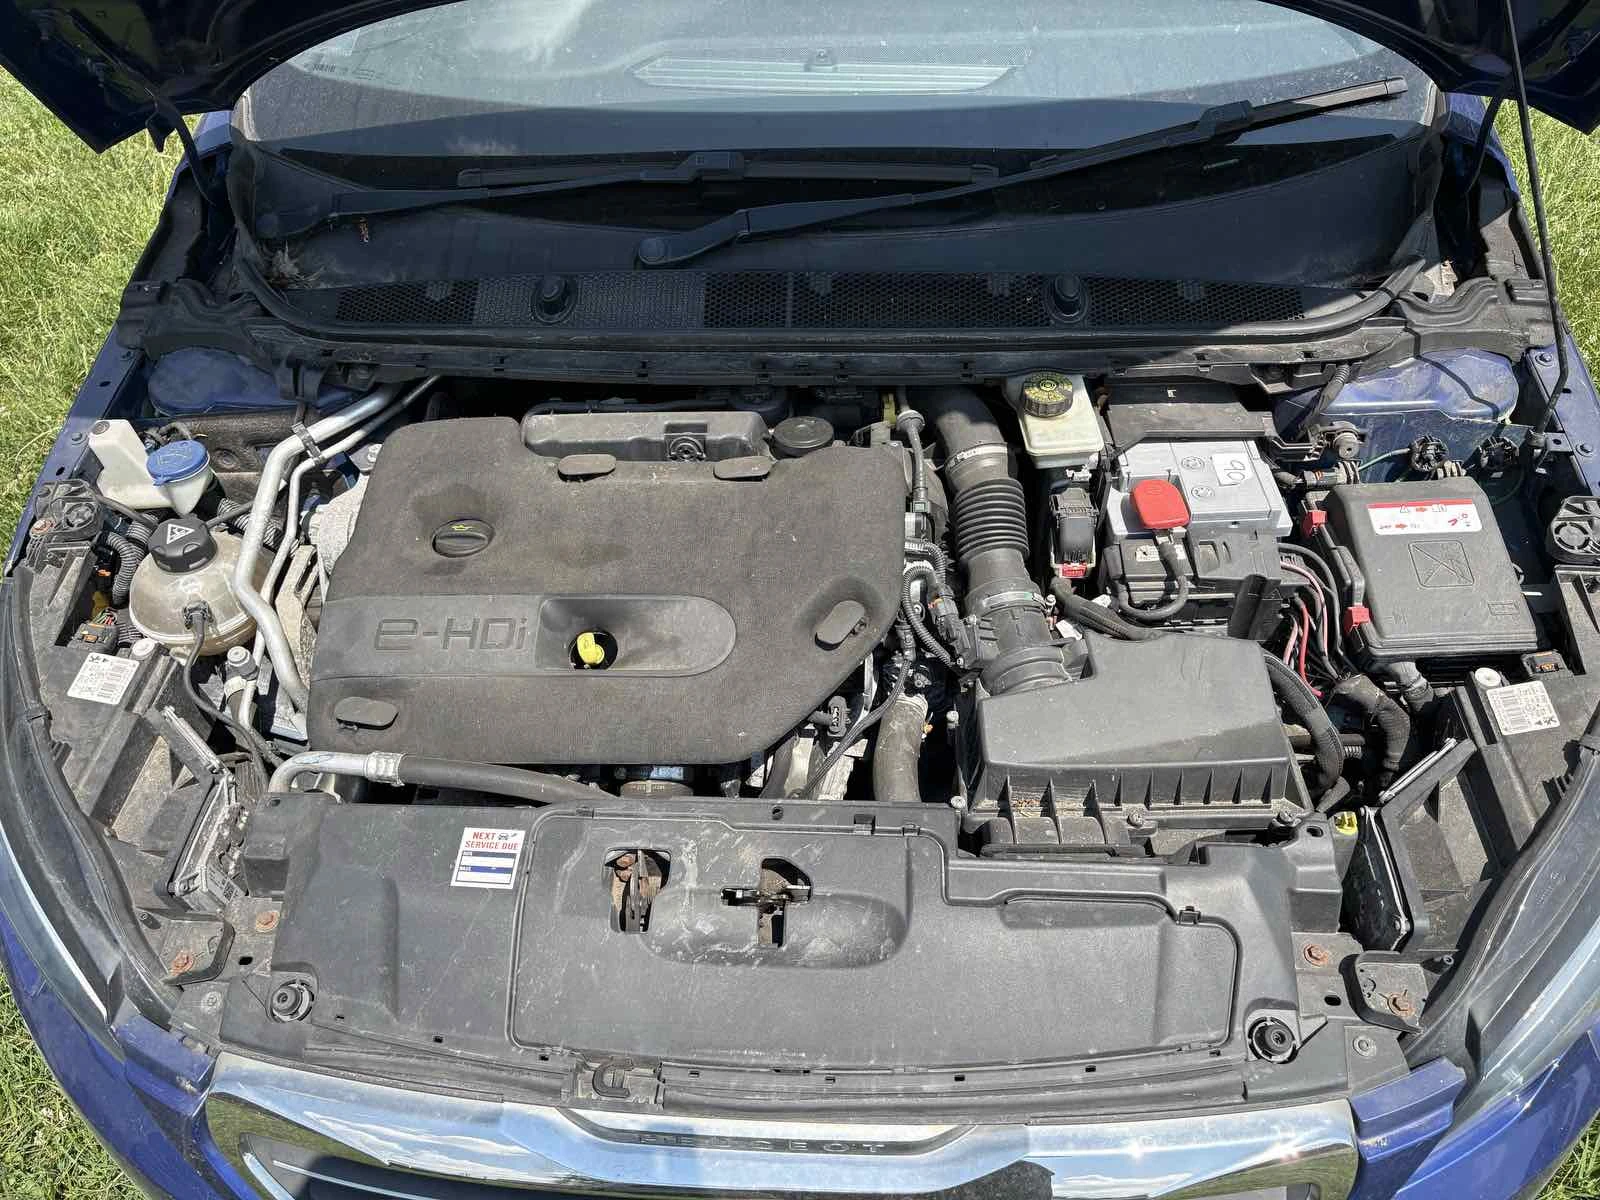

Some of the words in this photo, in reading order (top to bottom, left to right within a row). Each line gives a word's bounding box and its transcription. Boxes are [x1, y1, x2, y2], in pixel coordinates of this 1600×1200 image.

[374, 616, 528, 651] e-HDi
[472, 831, 497, 841] NEXT
[464, 840, 498, 850] SERVICE
[501, 842, 519, 851] DUE
